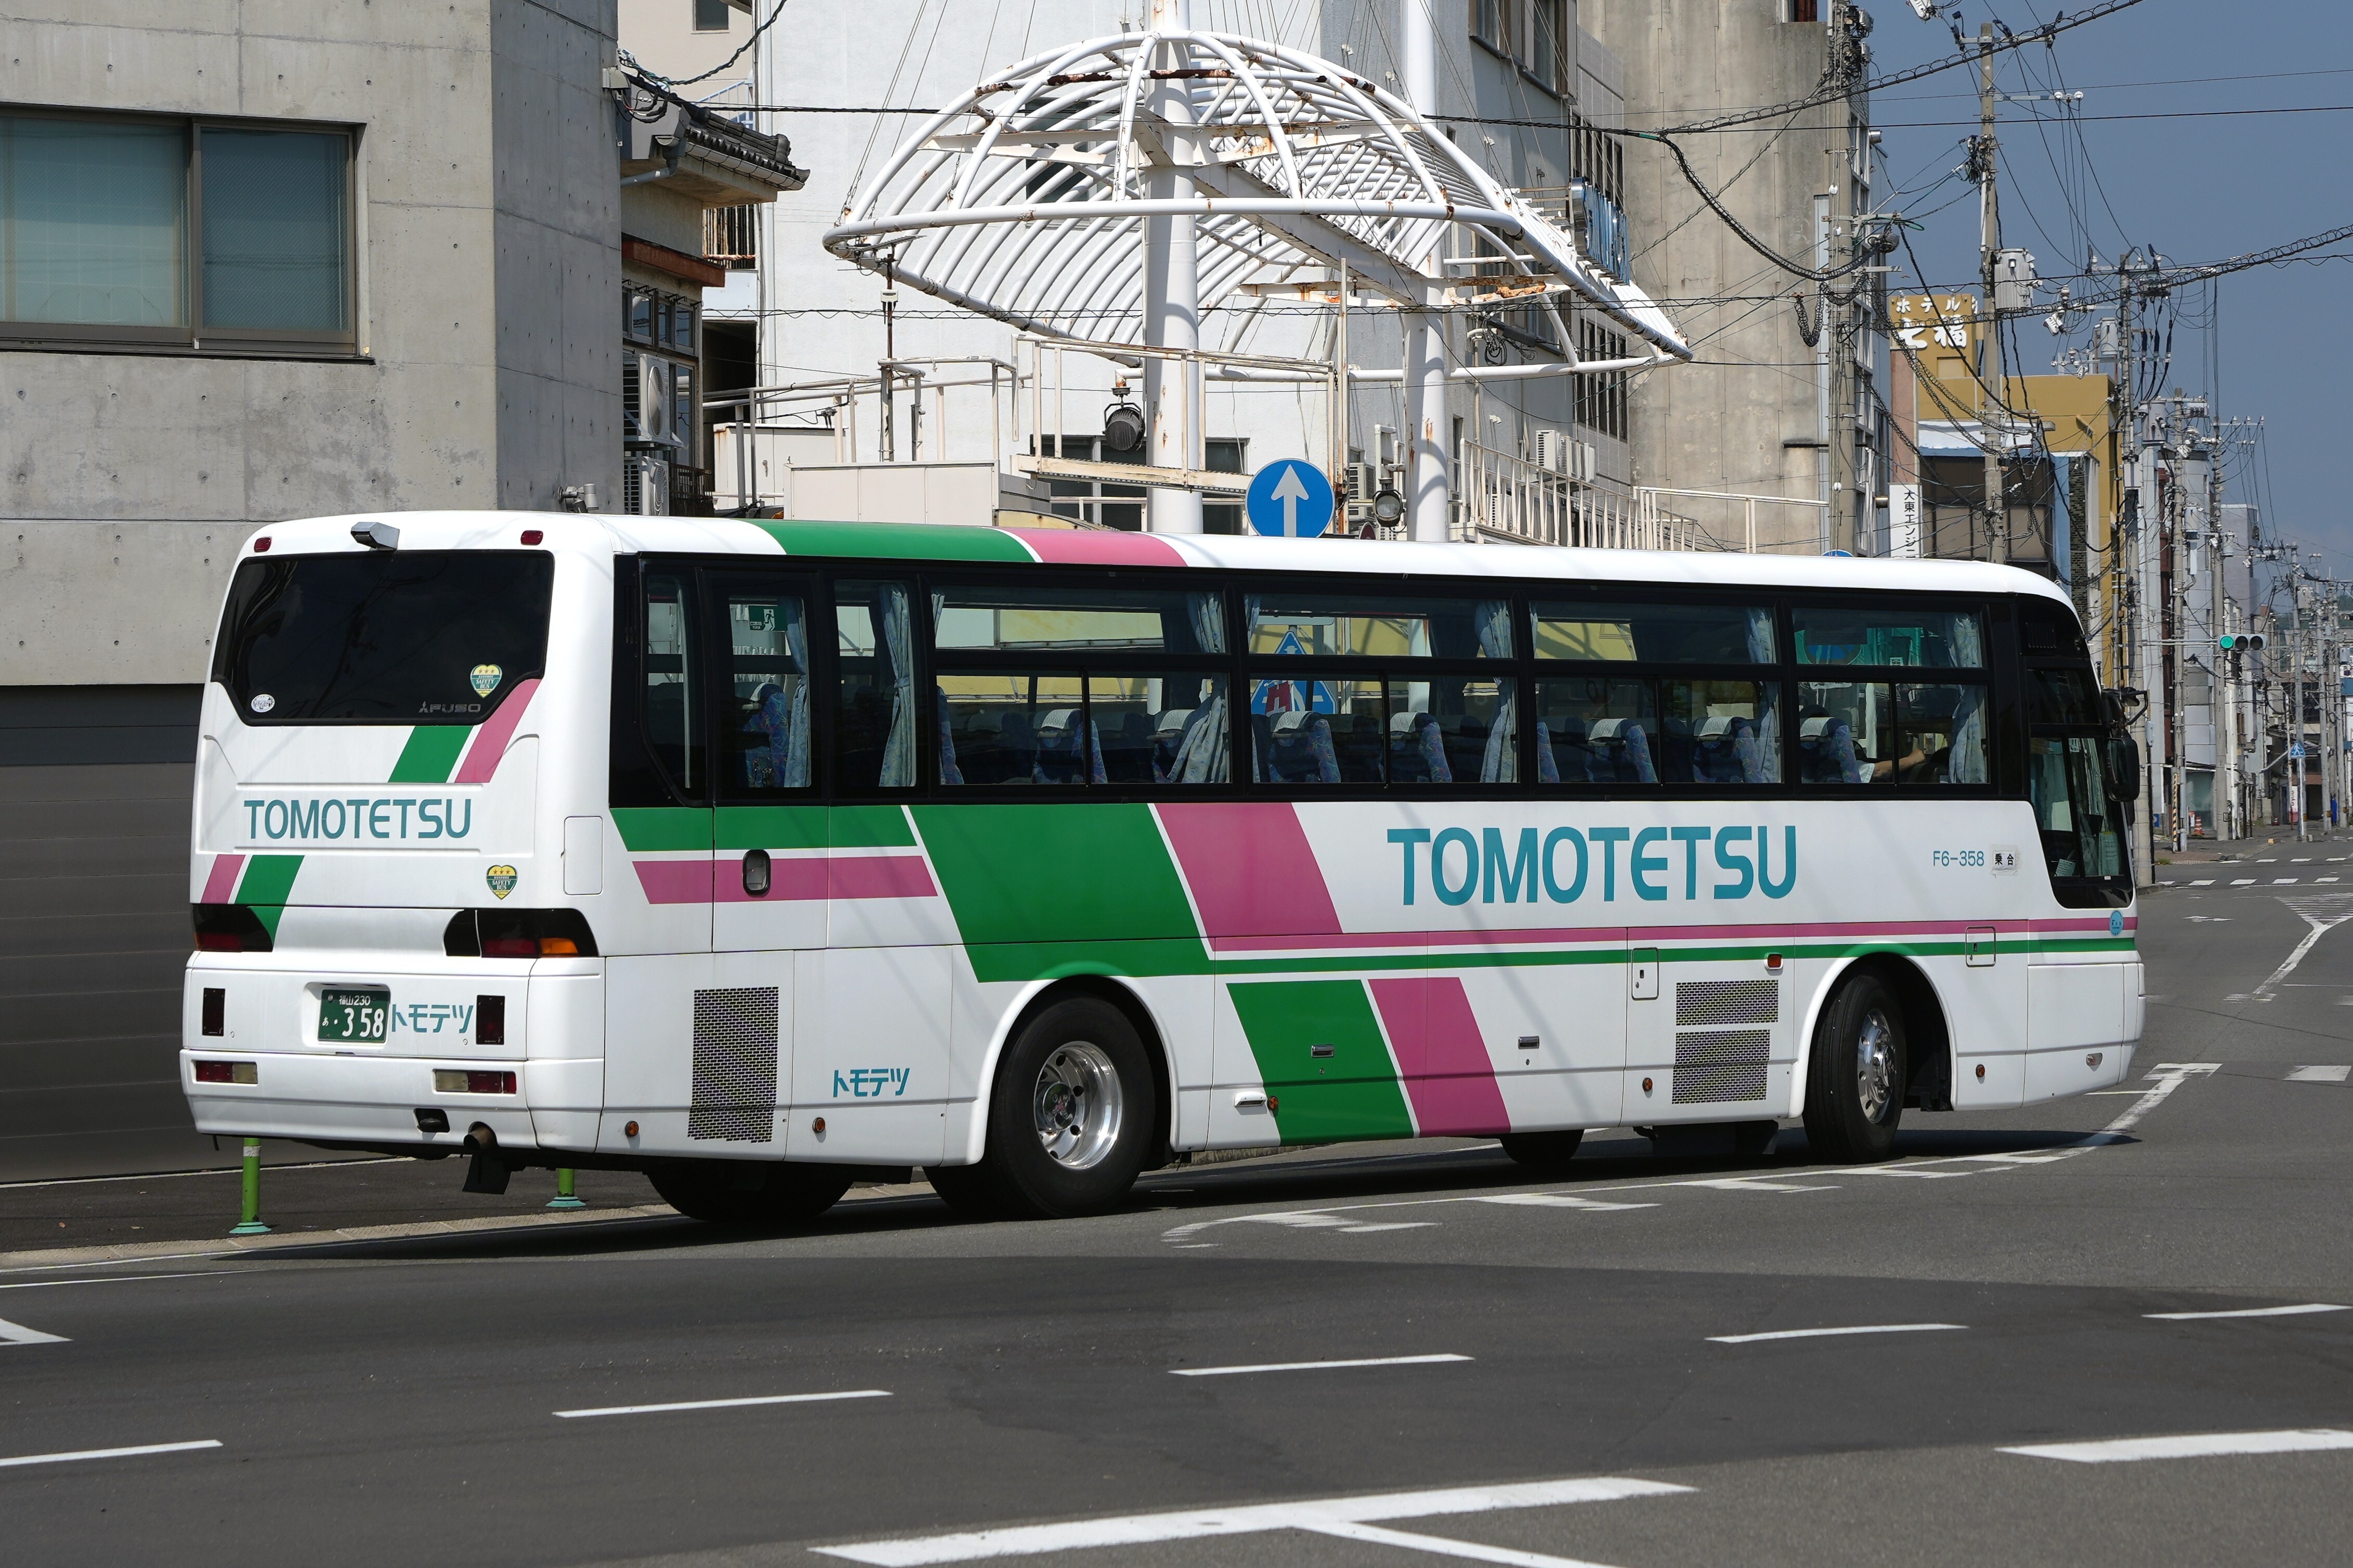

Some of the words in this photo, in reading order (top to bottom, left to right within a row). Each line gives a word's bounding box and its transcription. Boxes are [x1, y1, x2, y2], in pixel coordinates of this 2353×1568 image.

[1896, 297, 1960, 314] ホテル
[1898, 314, 1967, 349] 七福
[429, 704, 481, 714] FUSO
[244, 799, 471, 839] TOMOTETSU
[1387, 826, 1797, 906] TOMOTETSU
[1933, 851, 1984, 866] F6-358
[1995, 853, 2014, 866] 乗合
[322, 1017, 329, 1026] あ
[391, 1004, 474, 1034] トモテツ
[833, 1068, 910, 1098] トモテツ
